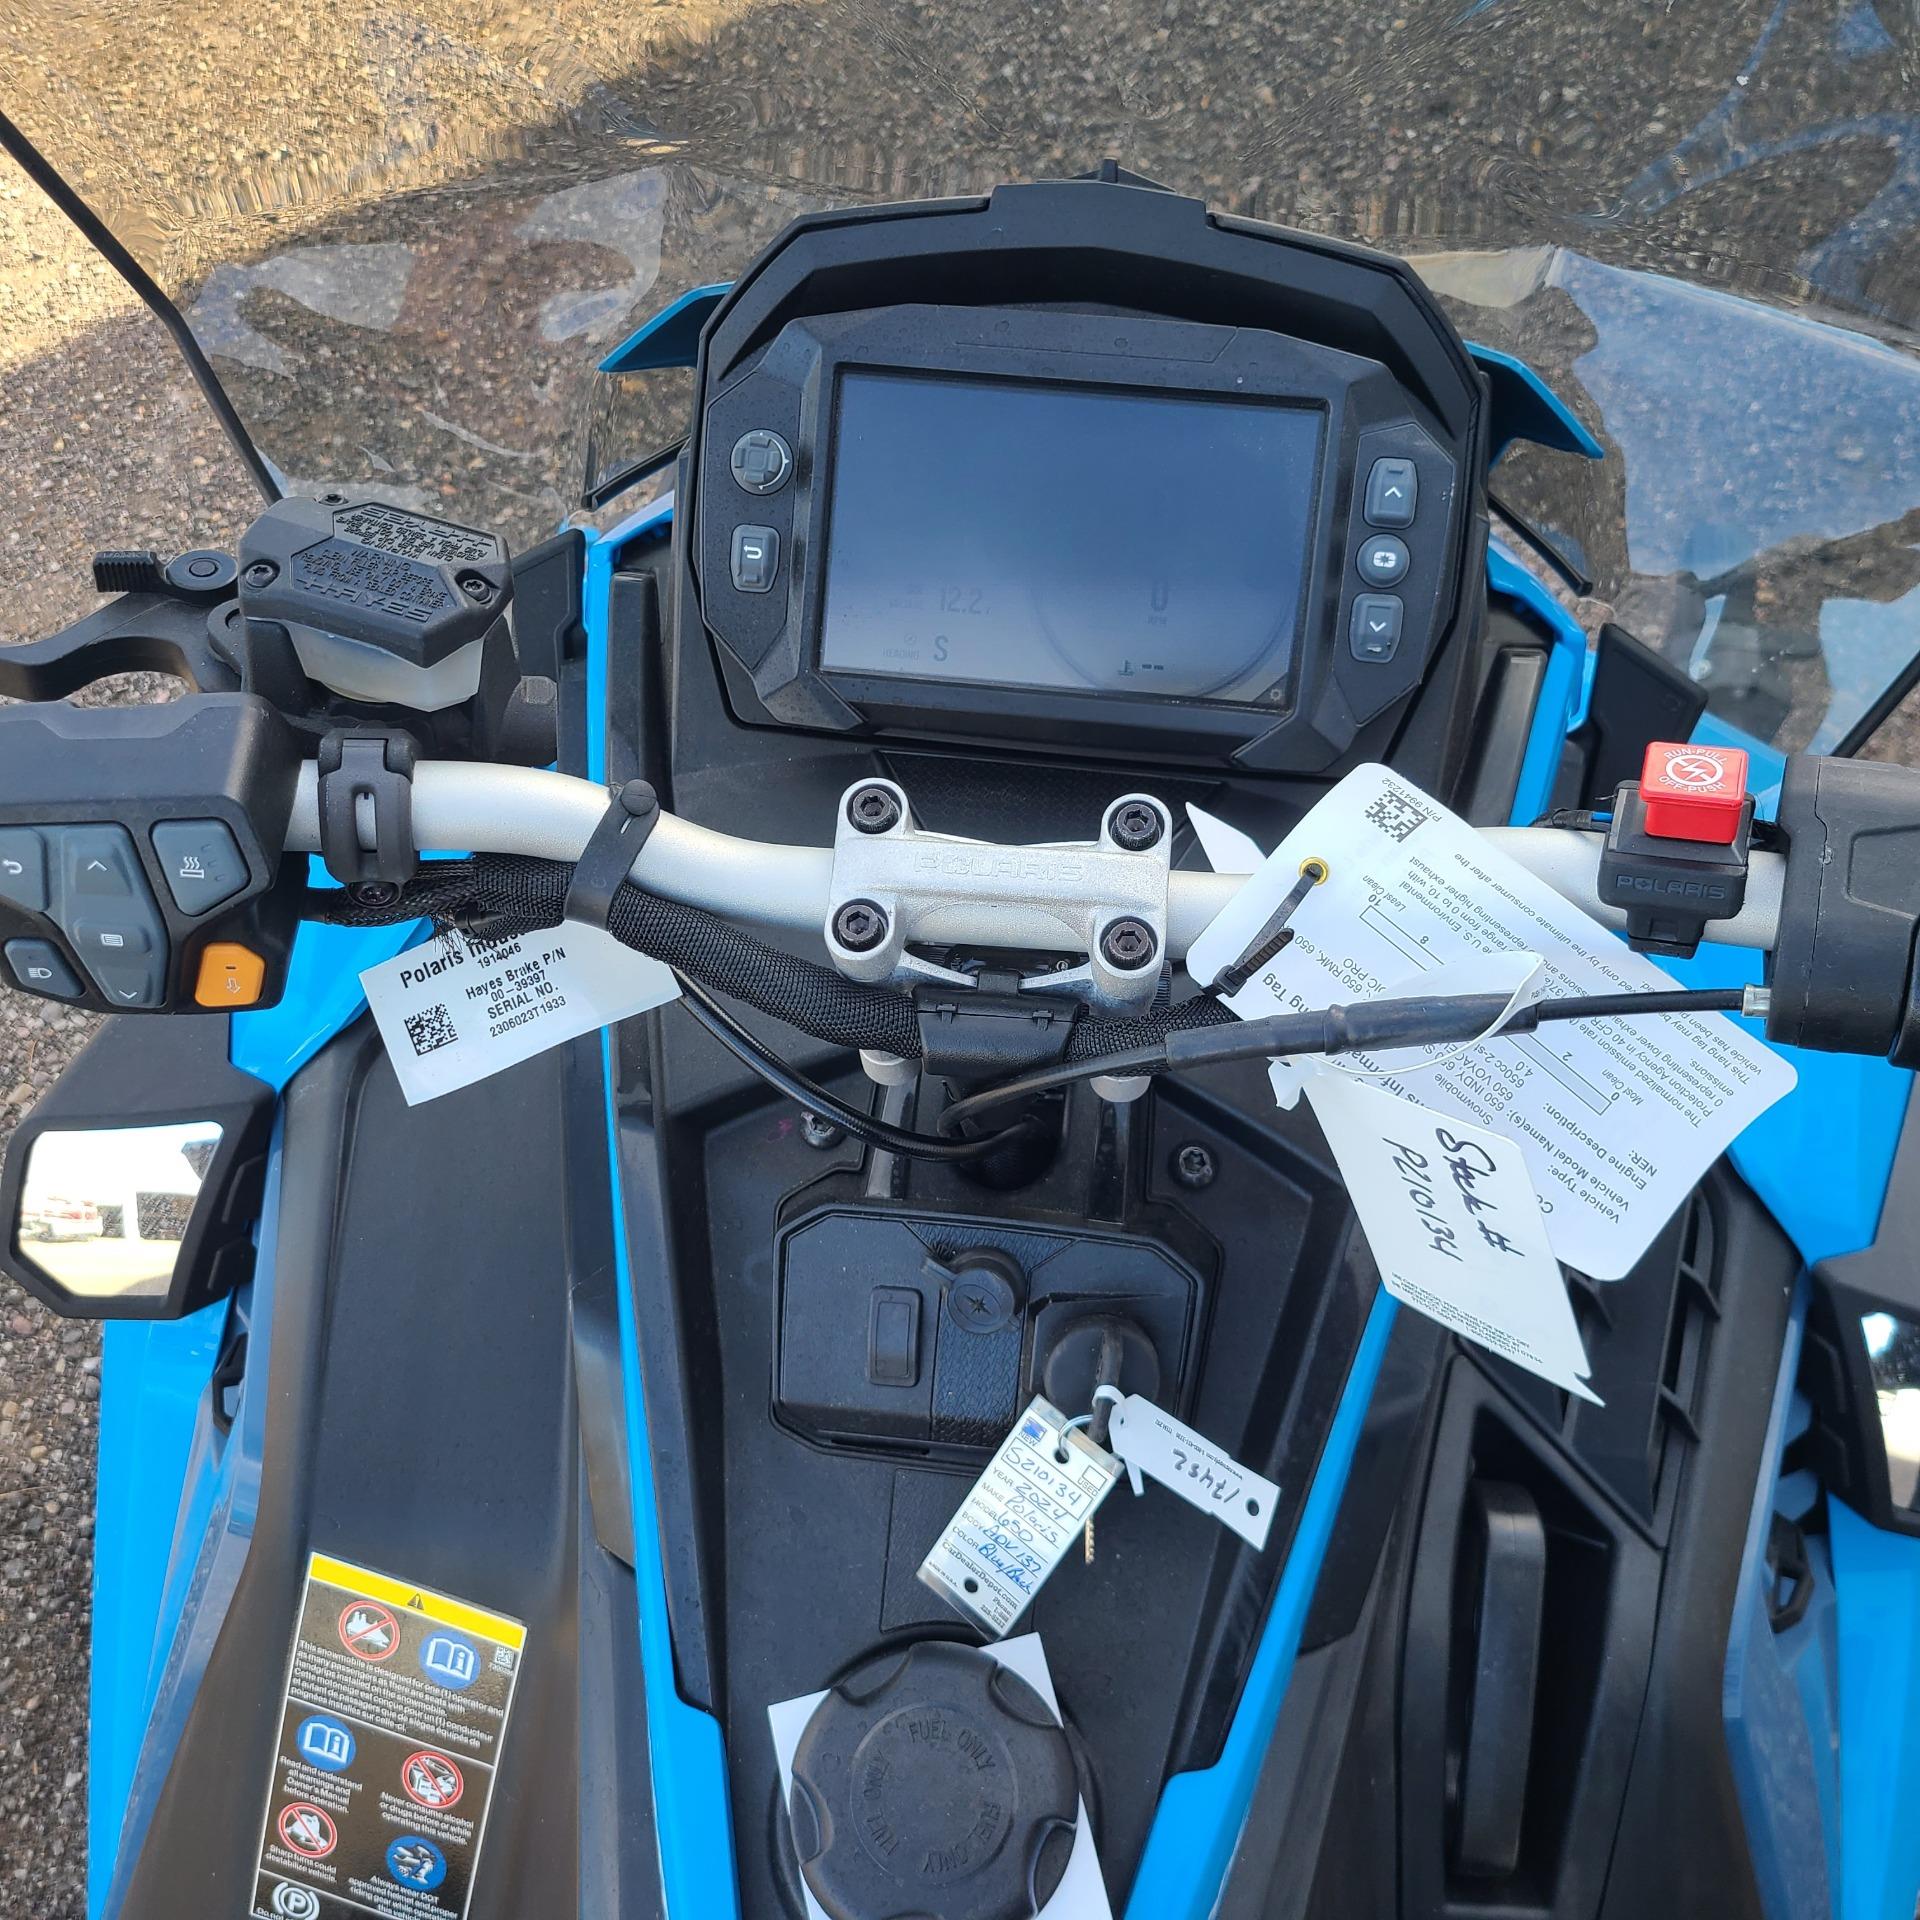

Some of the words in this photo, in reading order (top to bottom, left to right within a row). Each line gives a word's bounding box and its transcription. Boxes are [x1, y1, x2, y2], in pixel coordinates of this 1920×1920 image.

[932, 634, 949, 662] S
[1381, 774, 1423, 810] 9941232
[1422, 805, 1442, 823] P/N
[1408, 855, 1446, 887] exhaust
[1453, 851, 1470, 868] the
[1360, 873, 1386, 896] Clean
[1406, 869, 1427, 888] with
[1468, 863, 1492, 884] after
[1367, 892, 1382, 907] 10
[1425, 883, 1443, 900] 10,
[1442, 881, 1475, 910] higher
[1490, 880, 1536, 919] consumer
[1615, 874, 1726, 900] POLARIS
[1382, 891, 1406, 913] Least
[1398, 879, 1462, 932] Environmental
[1441, 896, 1453, 908] to
[1450, 904, 1460, 914] 0
[1458, 910, 1481, 931] from
[1471, 904, 1529, 952] representing
[1534, 914, 1572, 946] ultimate
[1293, 934, 1316, 955] 650
[1419, 934, 1429, 945] 8
[1460, 929, 1482, 949] U.S.
[1479, 926, 1508, 951] range
[1569, 941, 1587, 958] the
[400, 940, 464, 988] Polaris
[476, 942, 522, 969] 1914046
[1313, 949, 1344, 977] RMK,
[1341, 956, 1369, 981] PRO
[1585, 953, 1600, 967] by
[465, 974, 504, 1001] Hayes
[505, 958, 540, 982] Brake
[542, 946, 566, 965] P/N
[1341, 973, 1363, 993] 650
[1597, 962, 1620, 983] only
[486, 990, 533, 1019] SERIAL
[534, 979, 558, 998] NO.
[1259, 971, 1291, 1001] Tag
[488, 994, 567, 1037] 2306023T1933
[1670, 1017, 1693, 1038] may
[1687, 1016, 1713, 1039] been
[1577, 1022, 1598, 1041] rate
[1611, 1032, 1627, 1047] 40
[1691, 1034, 1709, 1050] tag
[1711, 1034, 1731, 1053] has
[1561, 1050, 1572, 1062] 2
[1595, 1037, 1638, 1073] emission
[1624, 1042, 1636, 1055] in
[1633, 1033, 1662, 1058] lower
[1706, 1046, 1732, 1069] hang
[1491, 1058, 1526, 1089] 650cc
[1514, 1059, 1534, 1079] 4.0
[1633, 1049, 1671, 1081] Agency
[1728, 1047, 1762, 1076] vehicle
[1729, 1064, 1751, 1085] This
[1453, 1066, 1486, 1095] INDY,
[1599, 1067, 1626, 1091] Clean
[1659, 1052, 1717, 1101] representing
[1686, 1057, 1735, 1098] emissions.
[1430, 1072, 1495, 1126] Snowmobile
[1482, 1090, 1506, 1112] 650
[1491, 1080, 1514, 1102] 650
[1610, 1090, 1620, 1101] 0
[1621, 1085, 1644, 1106] Most
[1633, 1068, 1686, 1113] normalized
[1666, 1077, 1714, 1117] Protection
[1713, 1097, 1723, 1108] 0
[1503, 1107, 1556, 1152] Name(s):
[1539, 1101, 1609, 1159] Description:
[1681, 1107, 1703, 1127] The
[1552, 1147, 1590, 1180] Model
[1605, 1153, 1648, 1191] Engine
[1626, 1148, 1658, 1177] NER:
[1545, 1161, 1580, 1193] Type:
[1577, 1187, 1621, 1224] Vehicle
[1588, 1174, 1631, 1211] Vehicle
[1004, 1440, 1081, 1511] S210134
[1018, 1430, 1037, 1447] NEW
[1076, 1477, 1098, 1497] USED
[992, 1466, 1013, 1486] YEAR
[1015, 1476, 1068, 1524] 2024
[971, 1495, 999, 1521] MODEL
[996, 1508, 1036, 1547] 650
[981, 1481, 1004, 1502] MAKE
[1005, 1490, 1063, 1543] Polaris
[951, 1525, 979, 1550] COLOR
[961, 1510, 984, 1531] BODY
[1015, 1548, 1042, 1574] 137
[909, 1719, 948, 1743] FUEL
[957, 1728, 996, 1770] ONLY
